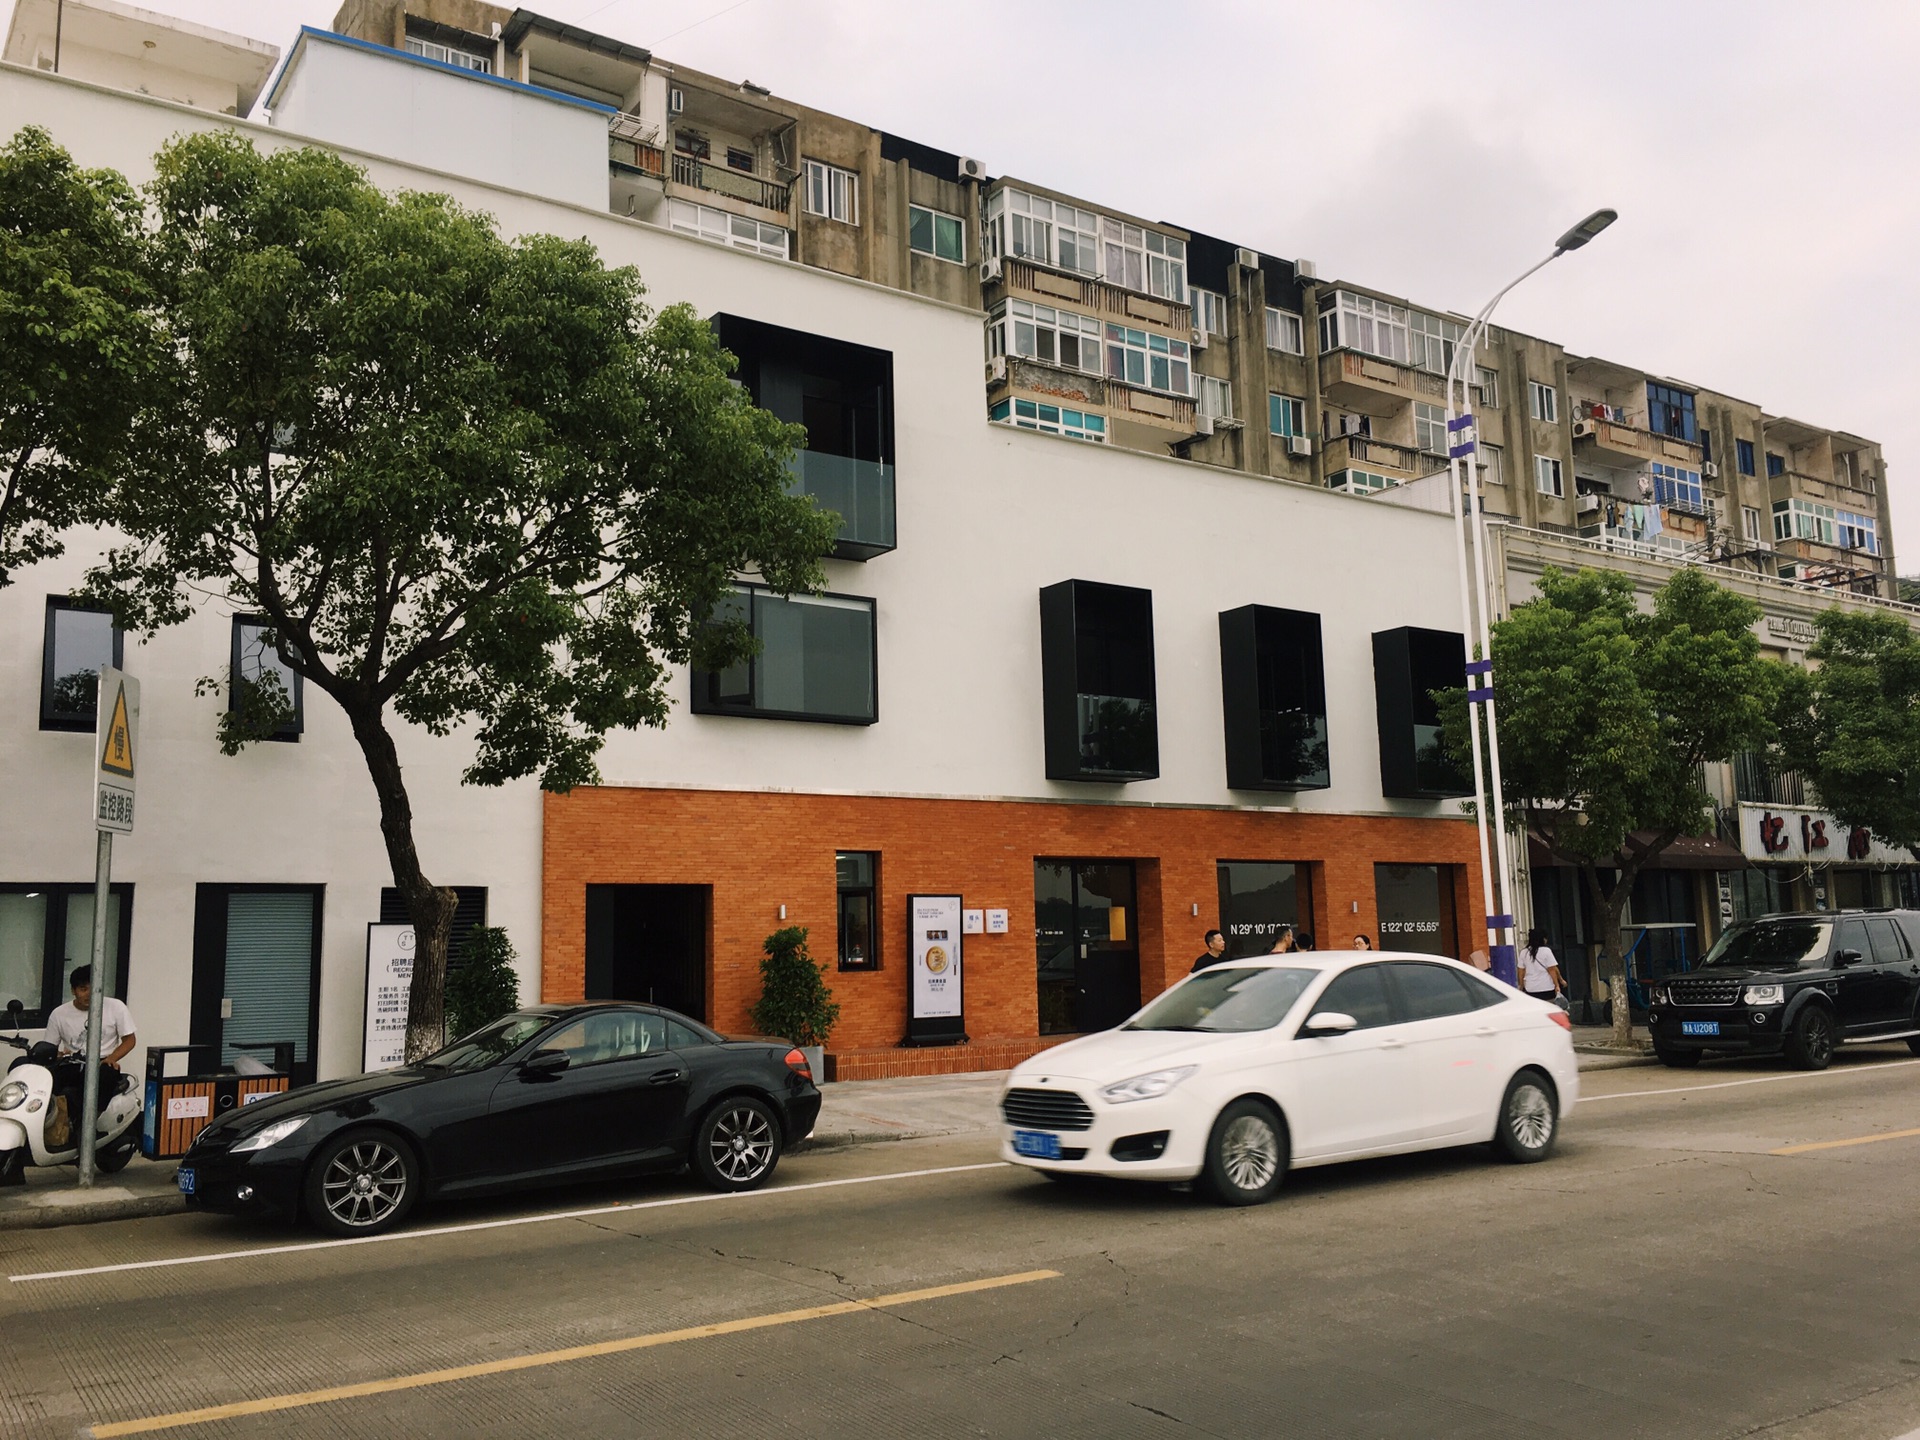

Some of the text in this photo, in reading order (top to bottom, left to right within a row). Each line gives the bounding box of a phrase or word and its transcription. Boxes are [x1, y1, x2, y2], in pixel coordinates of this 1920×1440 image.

[99, 790, 133, 824] 监控路段
[1230, 924, 1237, 935] N
[1381, 922, 1387, 932] E
[1387, 922, 1403, 932] 122°
